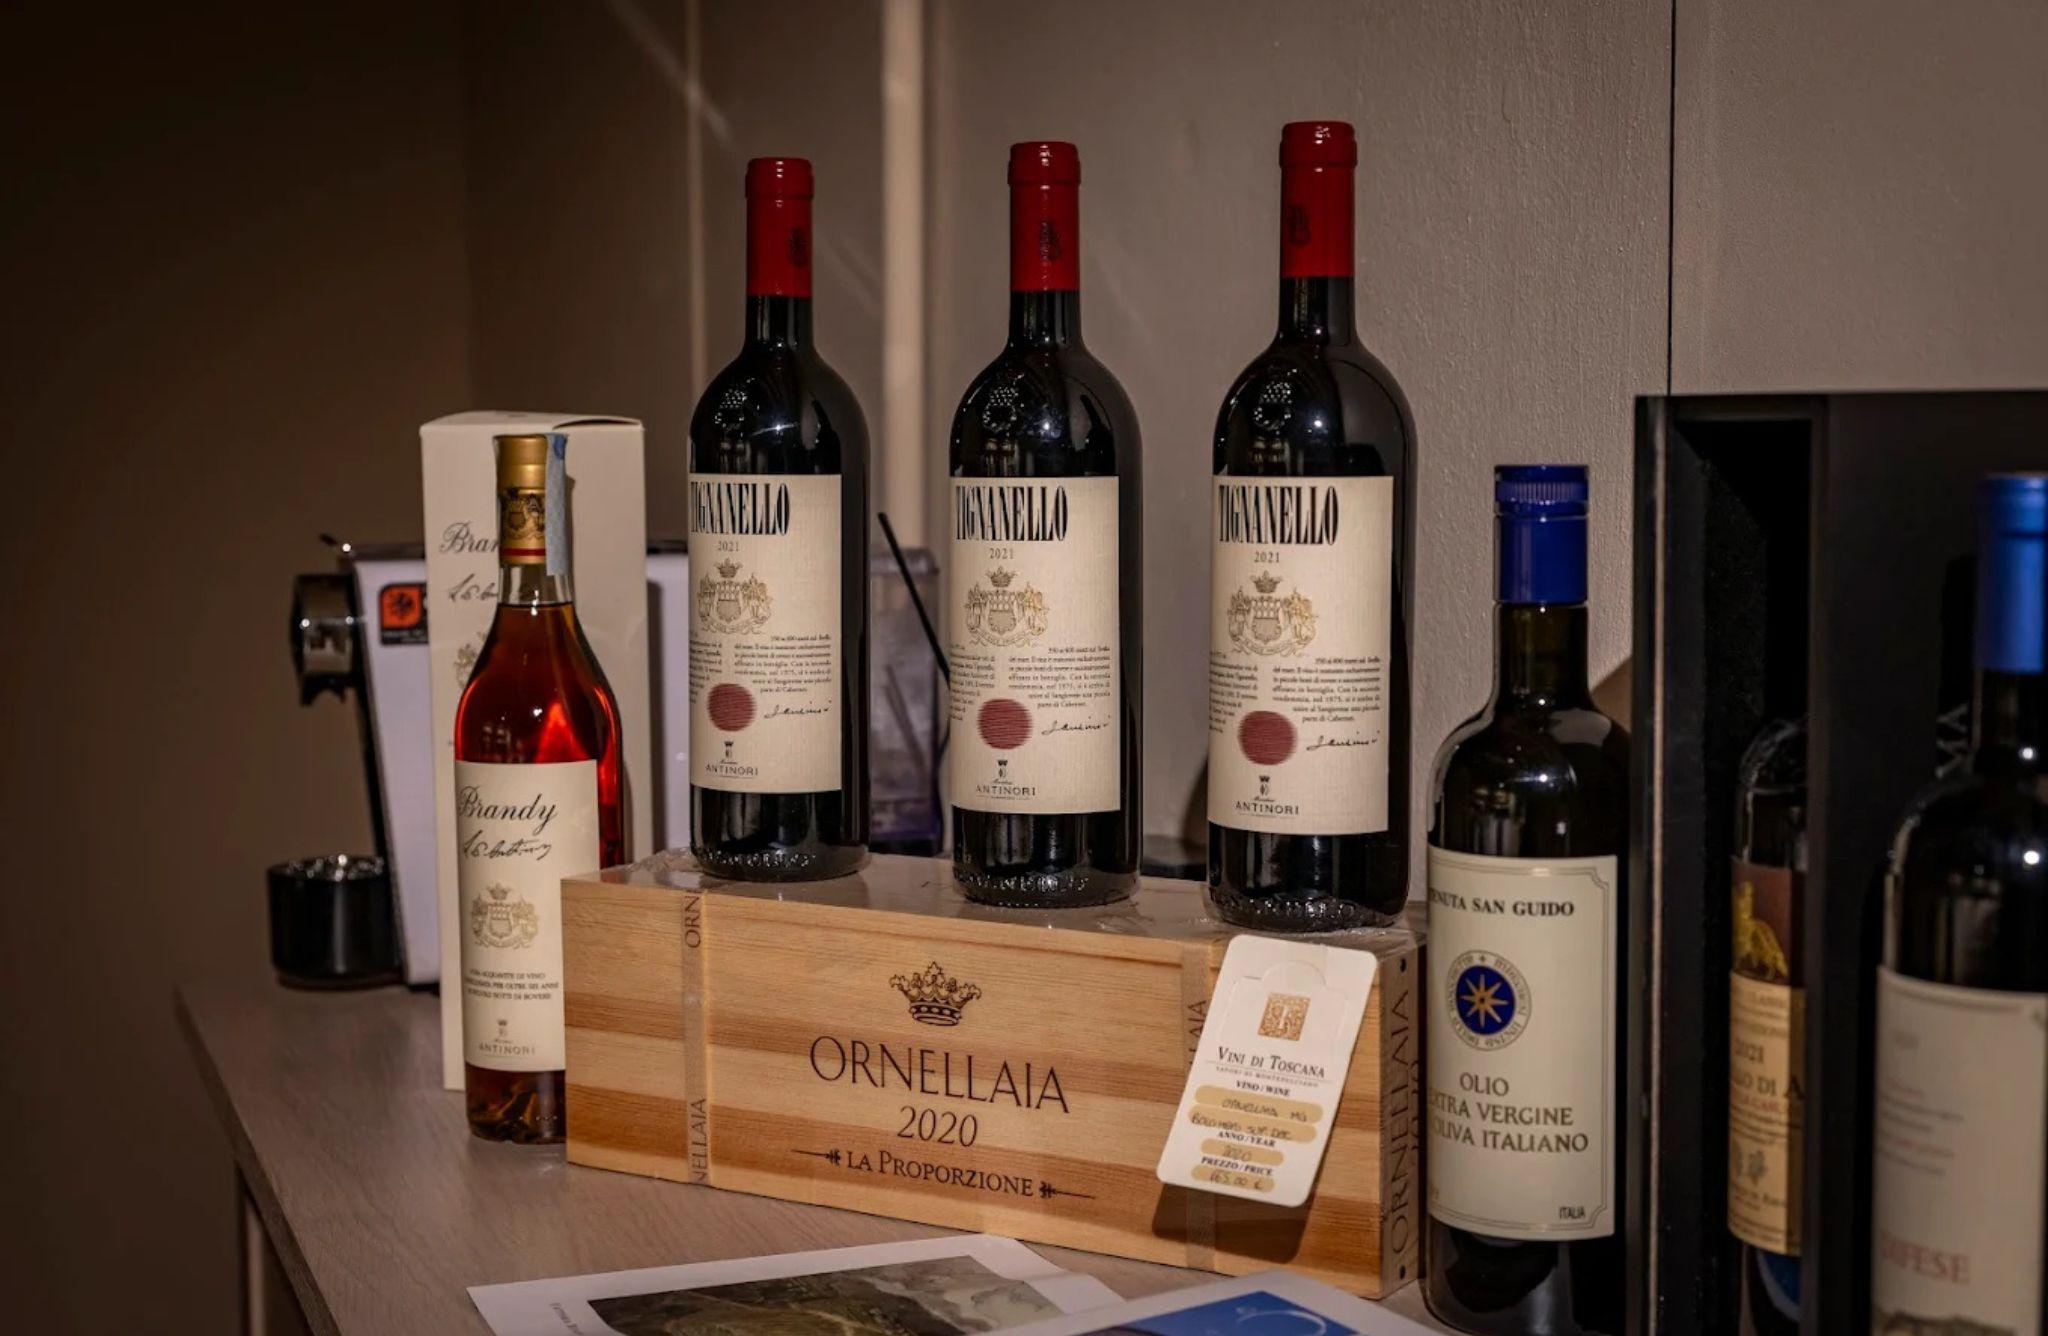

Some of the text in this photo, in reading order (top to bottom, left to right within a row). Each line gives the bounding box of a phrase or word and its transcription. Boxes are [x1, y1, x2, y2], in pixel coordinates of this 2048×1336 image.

[956, 485, 1068, 541] TIGNANELLO
[1219, 484, 1339, 545] TIGNANELLO
[718, 541, 740, 552] 2021
[990, 548, 1015, 559] 2021
[1254, 552, 1280, 563] 2021
[705, 764, 758, 776] ANTINORI
[975, 785, 1035, 796] ANTINORI
[460, 785, 558, 836] Brandy
[1235, 801, 1299, 815] ANTINORI
[1473, 897, 1505, 914] SAN
[1513, 901, 1574, 917] GUIDO
[478, 1042, 536, 1056] ANTINORI
[809, 1035, 1070, 1115] ORNELLAIA
[1459, 1072, 1509, 1097] OLIO
[1236, 1080, 1259, 1091] VINO
[1265, 1086, 1290, 1097] WINE
[1390, 989, 1409, 1253] ORNELLAIA
[1479, 1102, 1574, 1127] VERGINE
[897, 1106, 978, 1148] 2020
[1217, 1131, 1244, 1142] ANNO
[1250, 1136, 1276, 1148] YEAR
[1481, 1129, 1589, 1153] ITALIANO
[846, 1149, 1034, 1198] LA PROPORZIONE
[1201, 1156, 1238, 1170] PREZZO
[1244, 1164, 1274, 1177] PRICE
[1559, 1206, 1586, 1220] ITALIA
